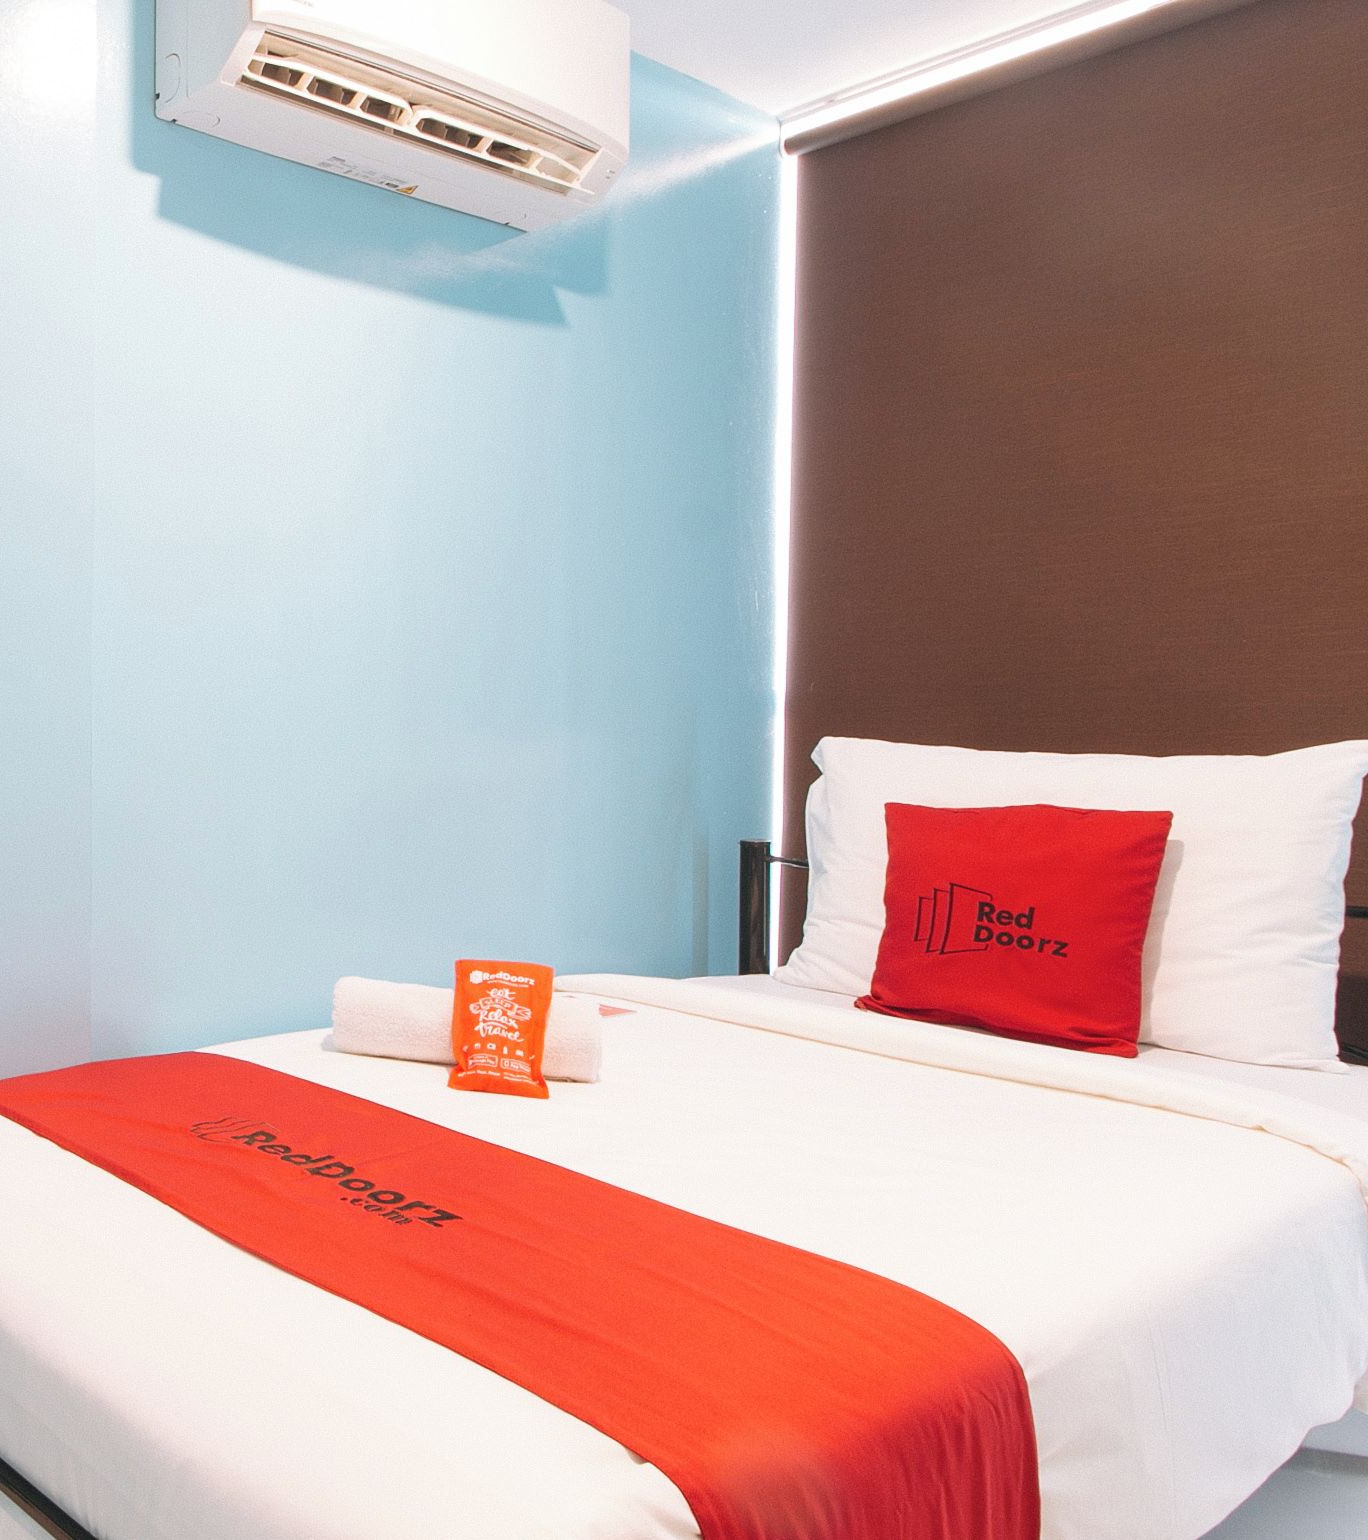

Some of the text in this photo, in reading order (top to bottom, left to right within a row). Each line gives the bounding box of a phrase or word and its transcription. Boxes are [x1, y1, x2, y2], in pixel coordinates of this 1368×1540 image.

[976, 901, 1036, 930] Red
[973, 924, 1069, 958] Doorz
[483, 971, 535, 986] RedDoorz
[232, 1130, 463, 1228] RedDoorz
[340, 1197, 413, 1226] .com
